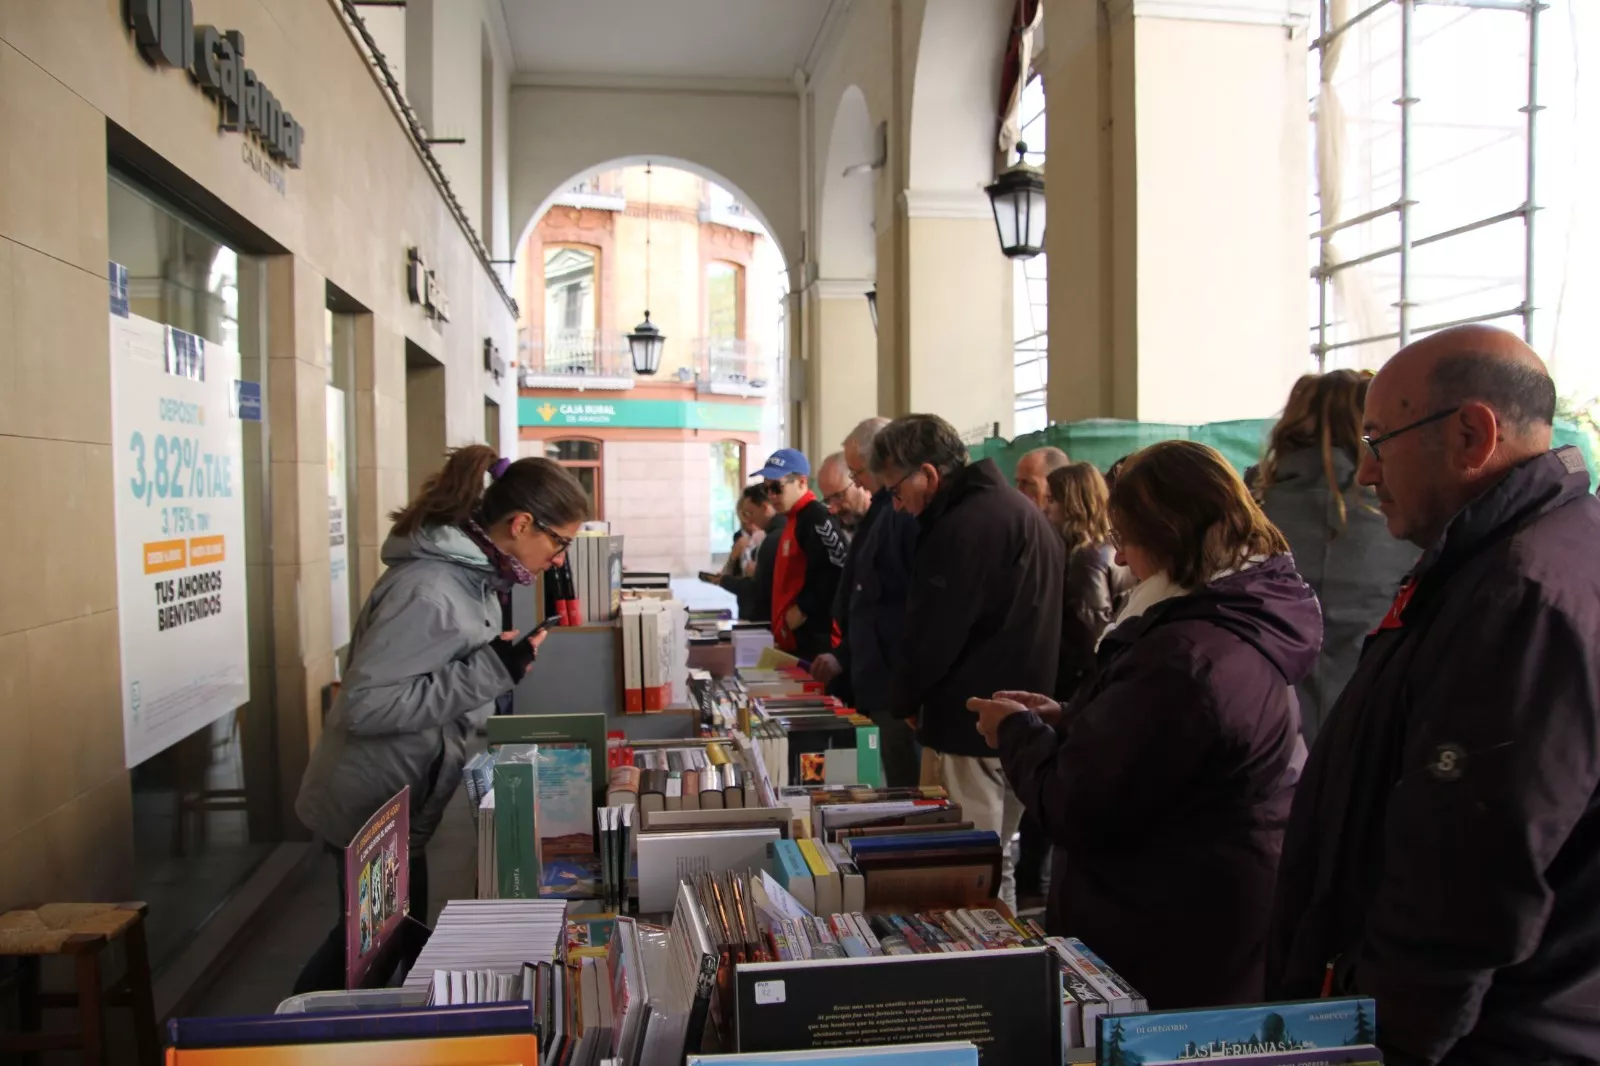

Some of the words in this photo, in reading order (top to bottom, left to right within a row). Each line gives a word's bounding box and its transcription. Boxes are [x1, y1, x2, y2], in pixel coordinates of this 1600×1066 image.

[195, 24, 304, 169] cajamar
[560, 404, 583, 414] CAJA
[129, 430, 204, 507] 3,82%
[203, 453, 232, 498] TAE
[155, 579, 174, 605] TUS
[178, 570, 222, 600] AHORROS
[158, 593, 221, 631] BIENVENIDOS
[1146, 1023, 1188, 1033] GREGORIO
